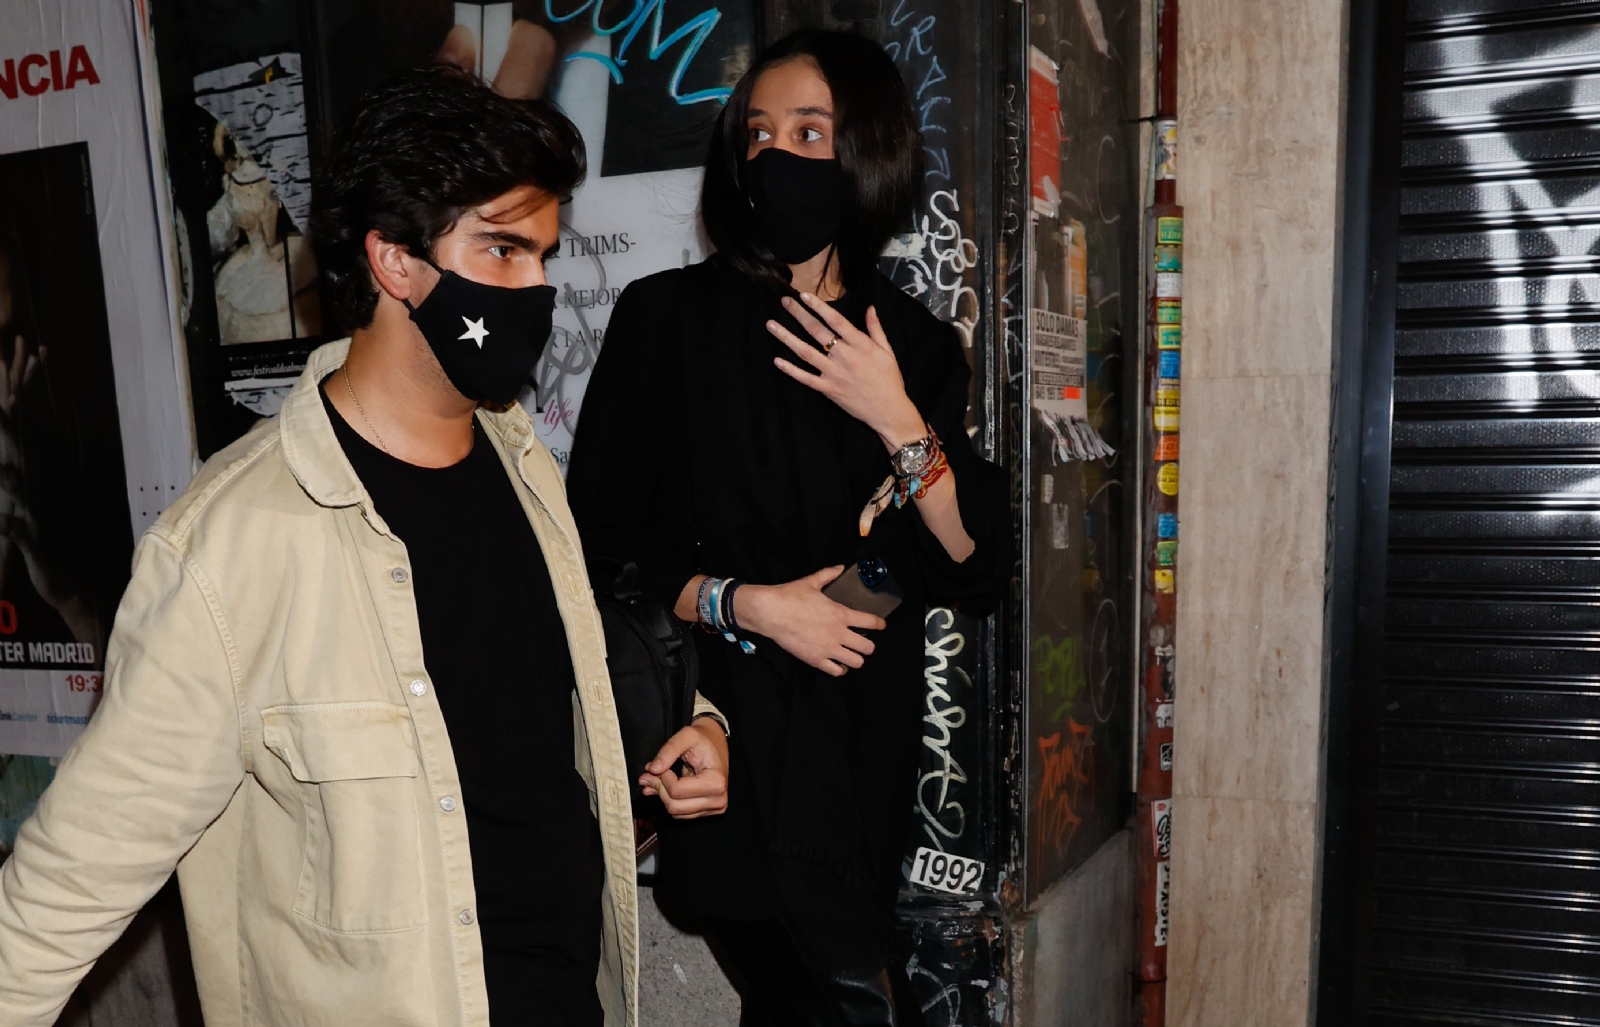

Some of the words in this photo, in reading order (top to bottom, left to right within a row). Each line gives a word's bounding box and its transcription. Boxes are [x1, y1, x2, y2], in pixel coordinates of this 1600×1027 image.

[0, 45, 101, 100] NCIA
[566, 232, 636, 257] TRIMS-
[1036, 312, 1055, 333] SOLO
[1056, 316, 1079, 338] DAMAS
[551, 447, 571, 464] Sa
[28, 642, 95, 664] MADRID
[47, 713, 91, 725] ticketmast
[917, 851, 983, 892] 1992
